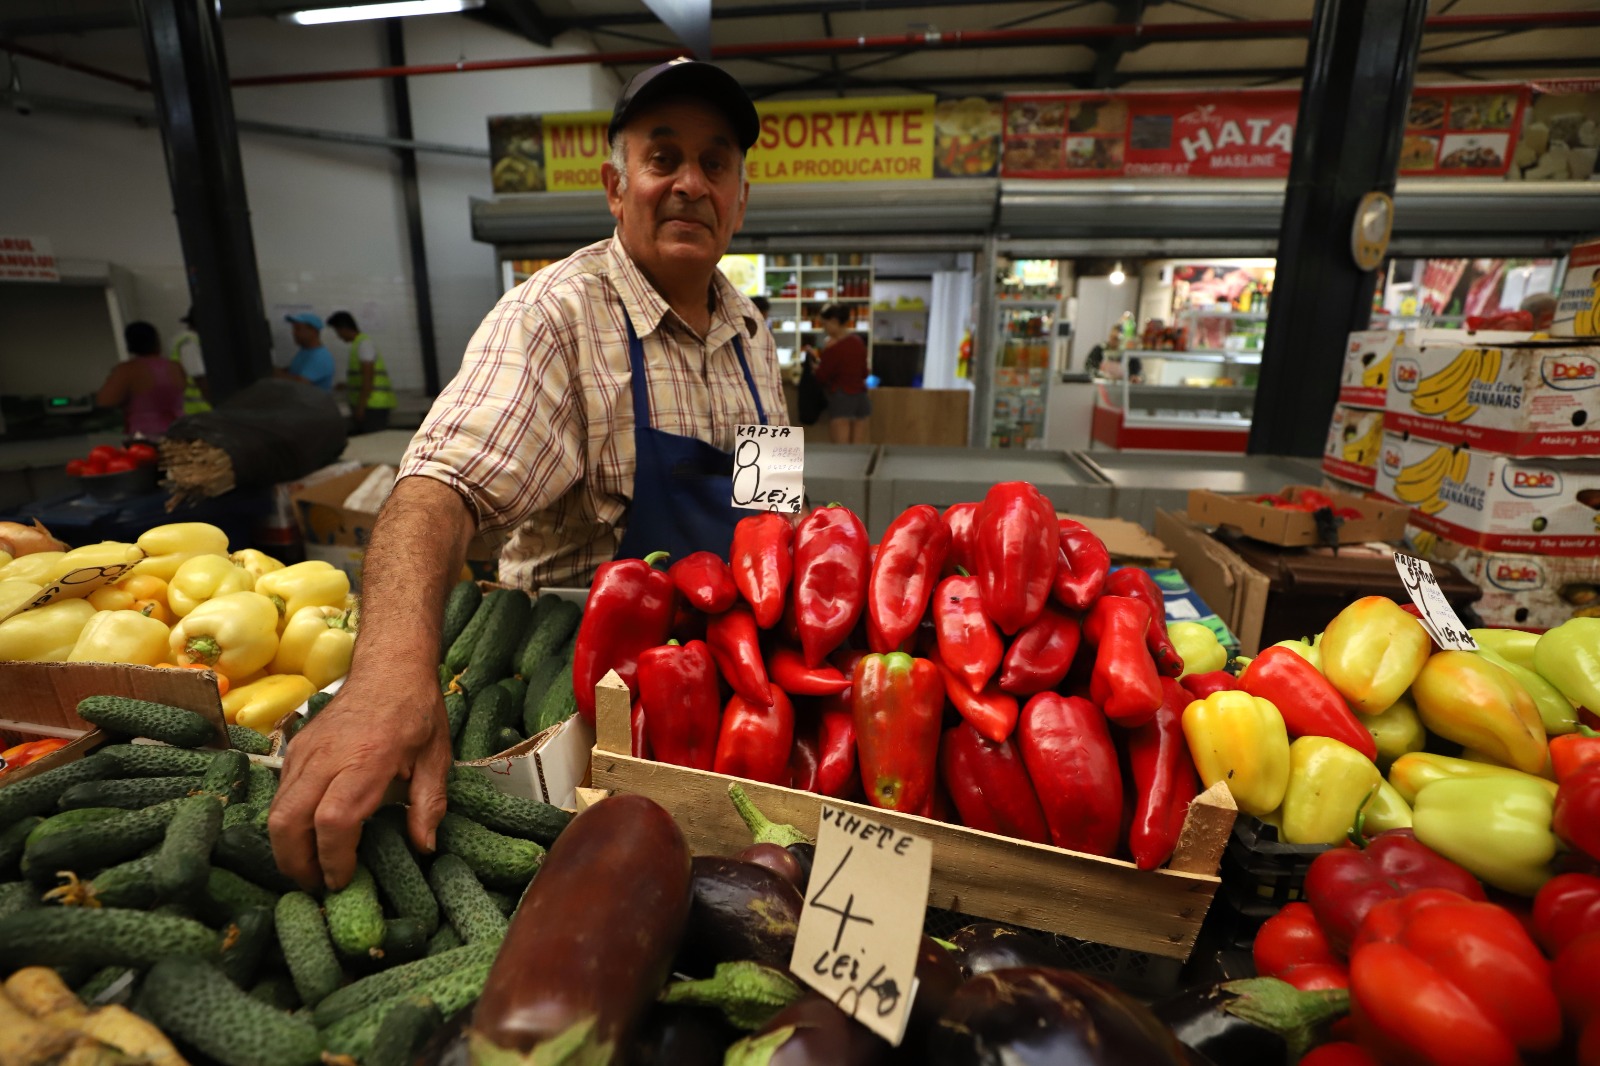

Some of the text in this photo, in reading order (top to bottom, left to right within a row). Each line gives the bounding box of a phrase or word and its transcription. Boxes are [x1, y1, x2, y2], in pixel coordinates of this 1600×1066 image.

[752, 110, 924, 151] SORTATE
[1180, 119, 1293, 162] HATA
[765, 162, 788, 178] LA
[793, 157, 922, 177] PRODUCATOR
[1210, 154, 1275, 168] MASLINE
[1553, 362, 1597, 379] Dole
[1496, 382, 1523, 394] Extra
[1468, 391, 1521, 410] BANANAS
[1540, 434, 1600, 447] Making The
[732, 440, 760, 506] 8
[1514, 472, 1555, 488] Dole
[1497, 565, 1536, 580] Dole
[809, 846, 875, 951] 4
